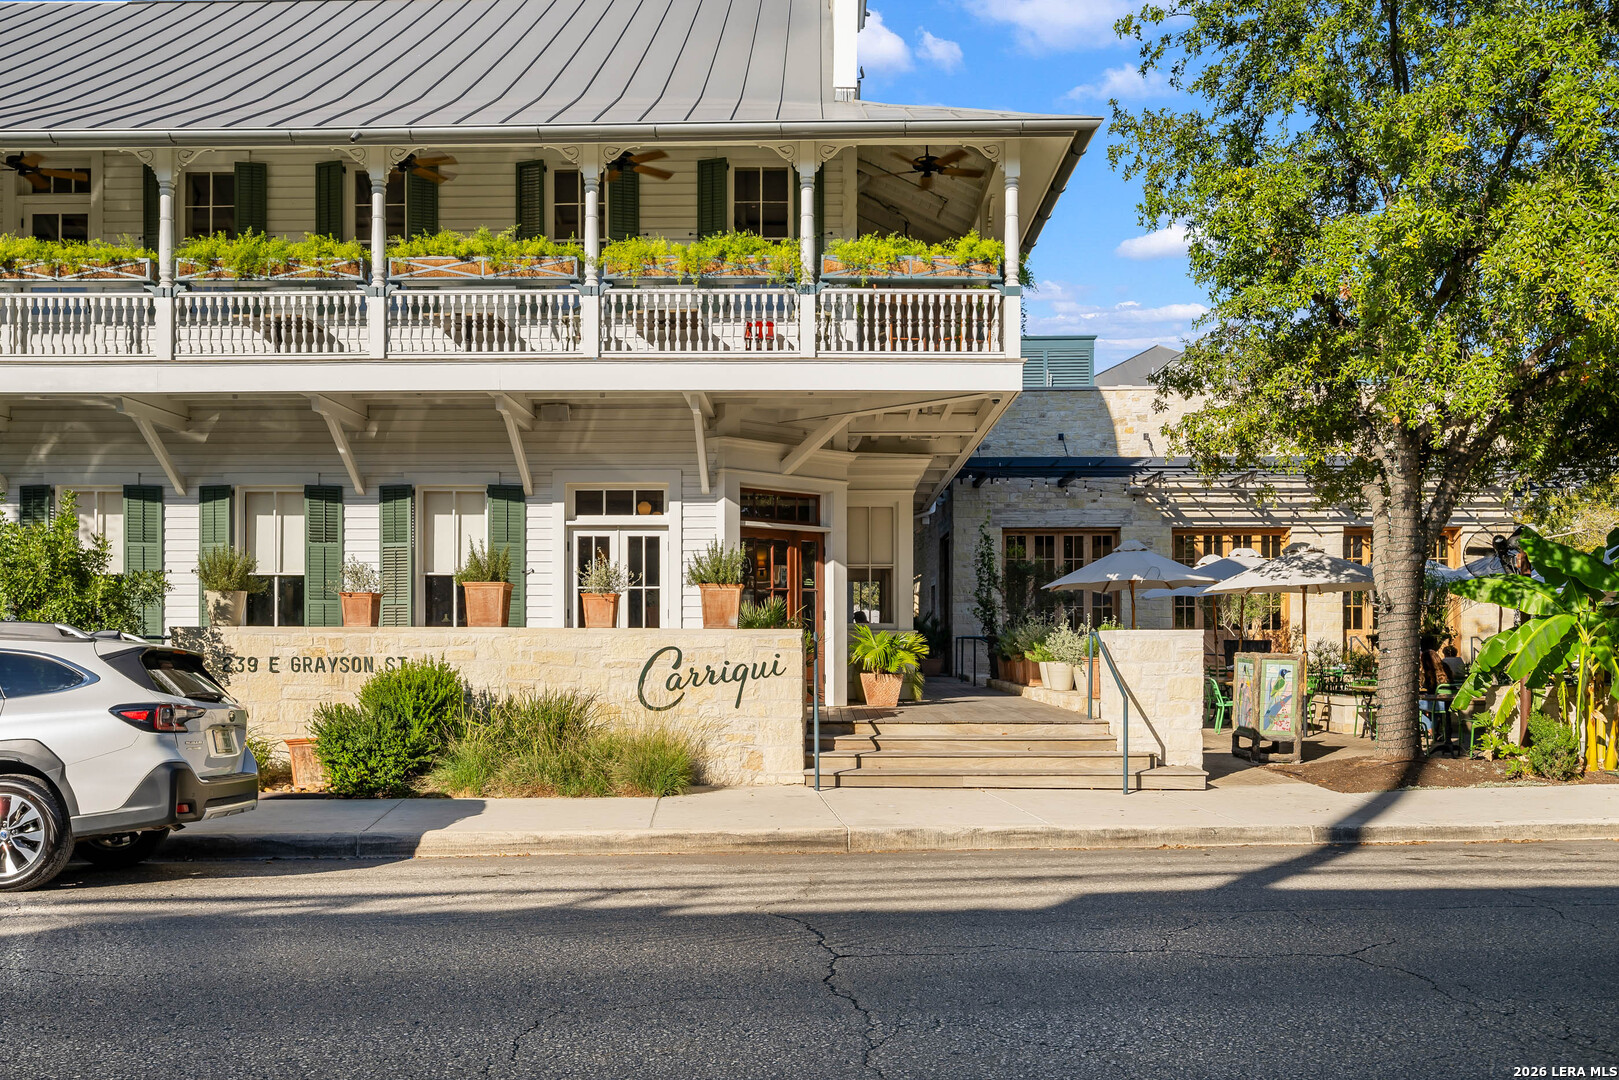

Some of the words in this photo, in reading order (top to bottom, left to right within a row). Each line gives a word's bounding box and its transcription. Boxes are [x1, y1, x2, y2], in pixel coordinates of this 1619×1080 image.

[223, 656, 258, 673] 239
[269, 656, 280, 674] E
[291, 656, 374, 674] GRAYSON
[385, 656, 408, 673] ST
[637, 645, 787, 712] Carriqui
